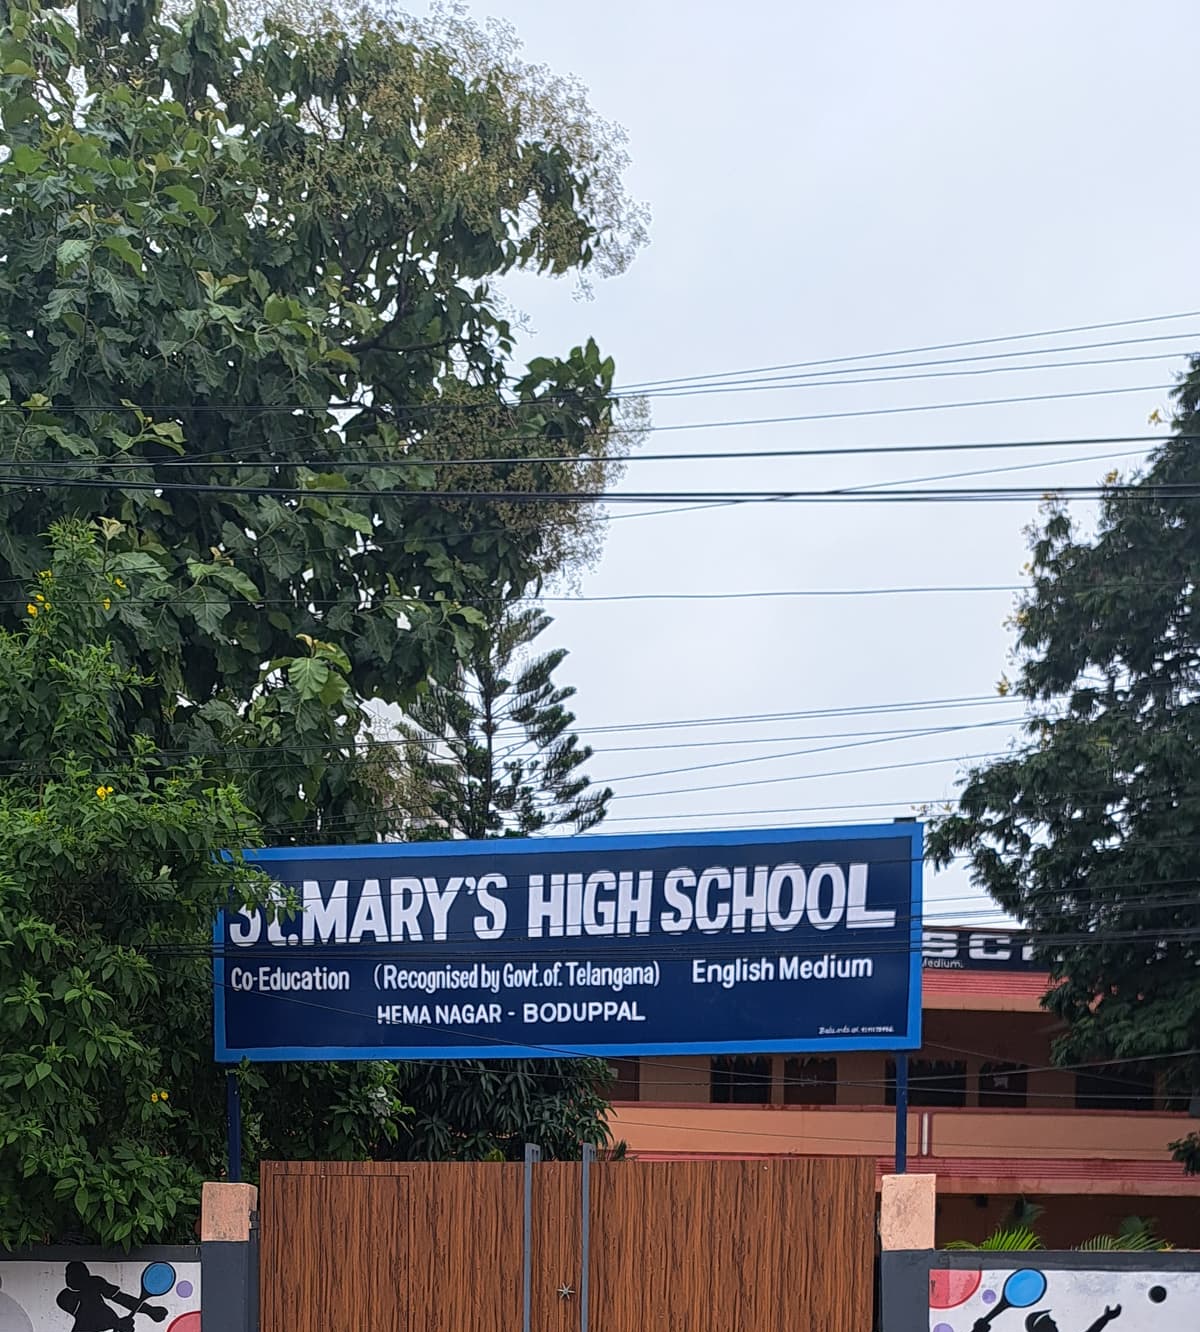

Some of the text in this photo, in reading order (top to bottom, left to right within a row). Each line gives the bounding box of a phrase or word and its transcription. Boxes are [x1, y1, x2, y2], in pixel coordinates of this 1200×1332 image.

[527, 869, 653, 938] HIGH
[660, 862, 896, 935] SCHOOL
[230, 966, 350, 992] Co-Education
[374, 963, 478, 994] (Recognised
[480, 963, 500, 993] by
[565, 960, 660, 992] Telangana)
[692, 958, 774, 989] English
[779, 955, 873, 981] Medium
[377, 1004, 432, 1025] HEMA
[435, 1003, 502, 1025] NAGAR
[523, 1001, 646, 1024] BODUPPAL
